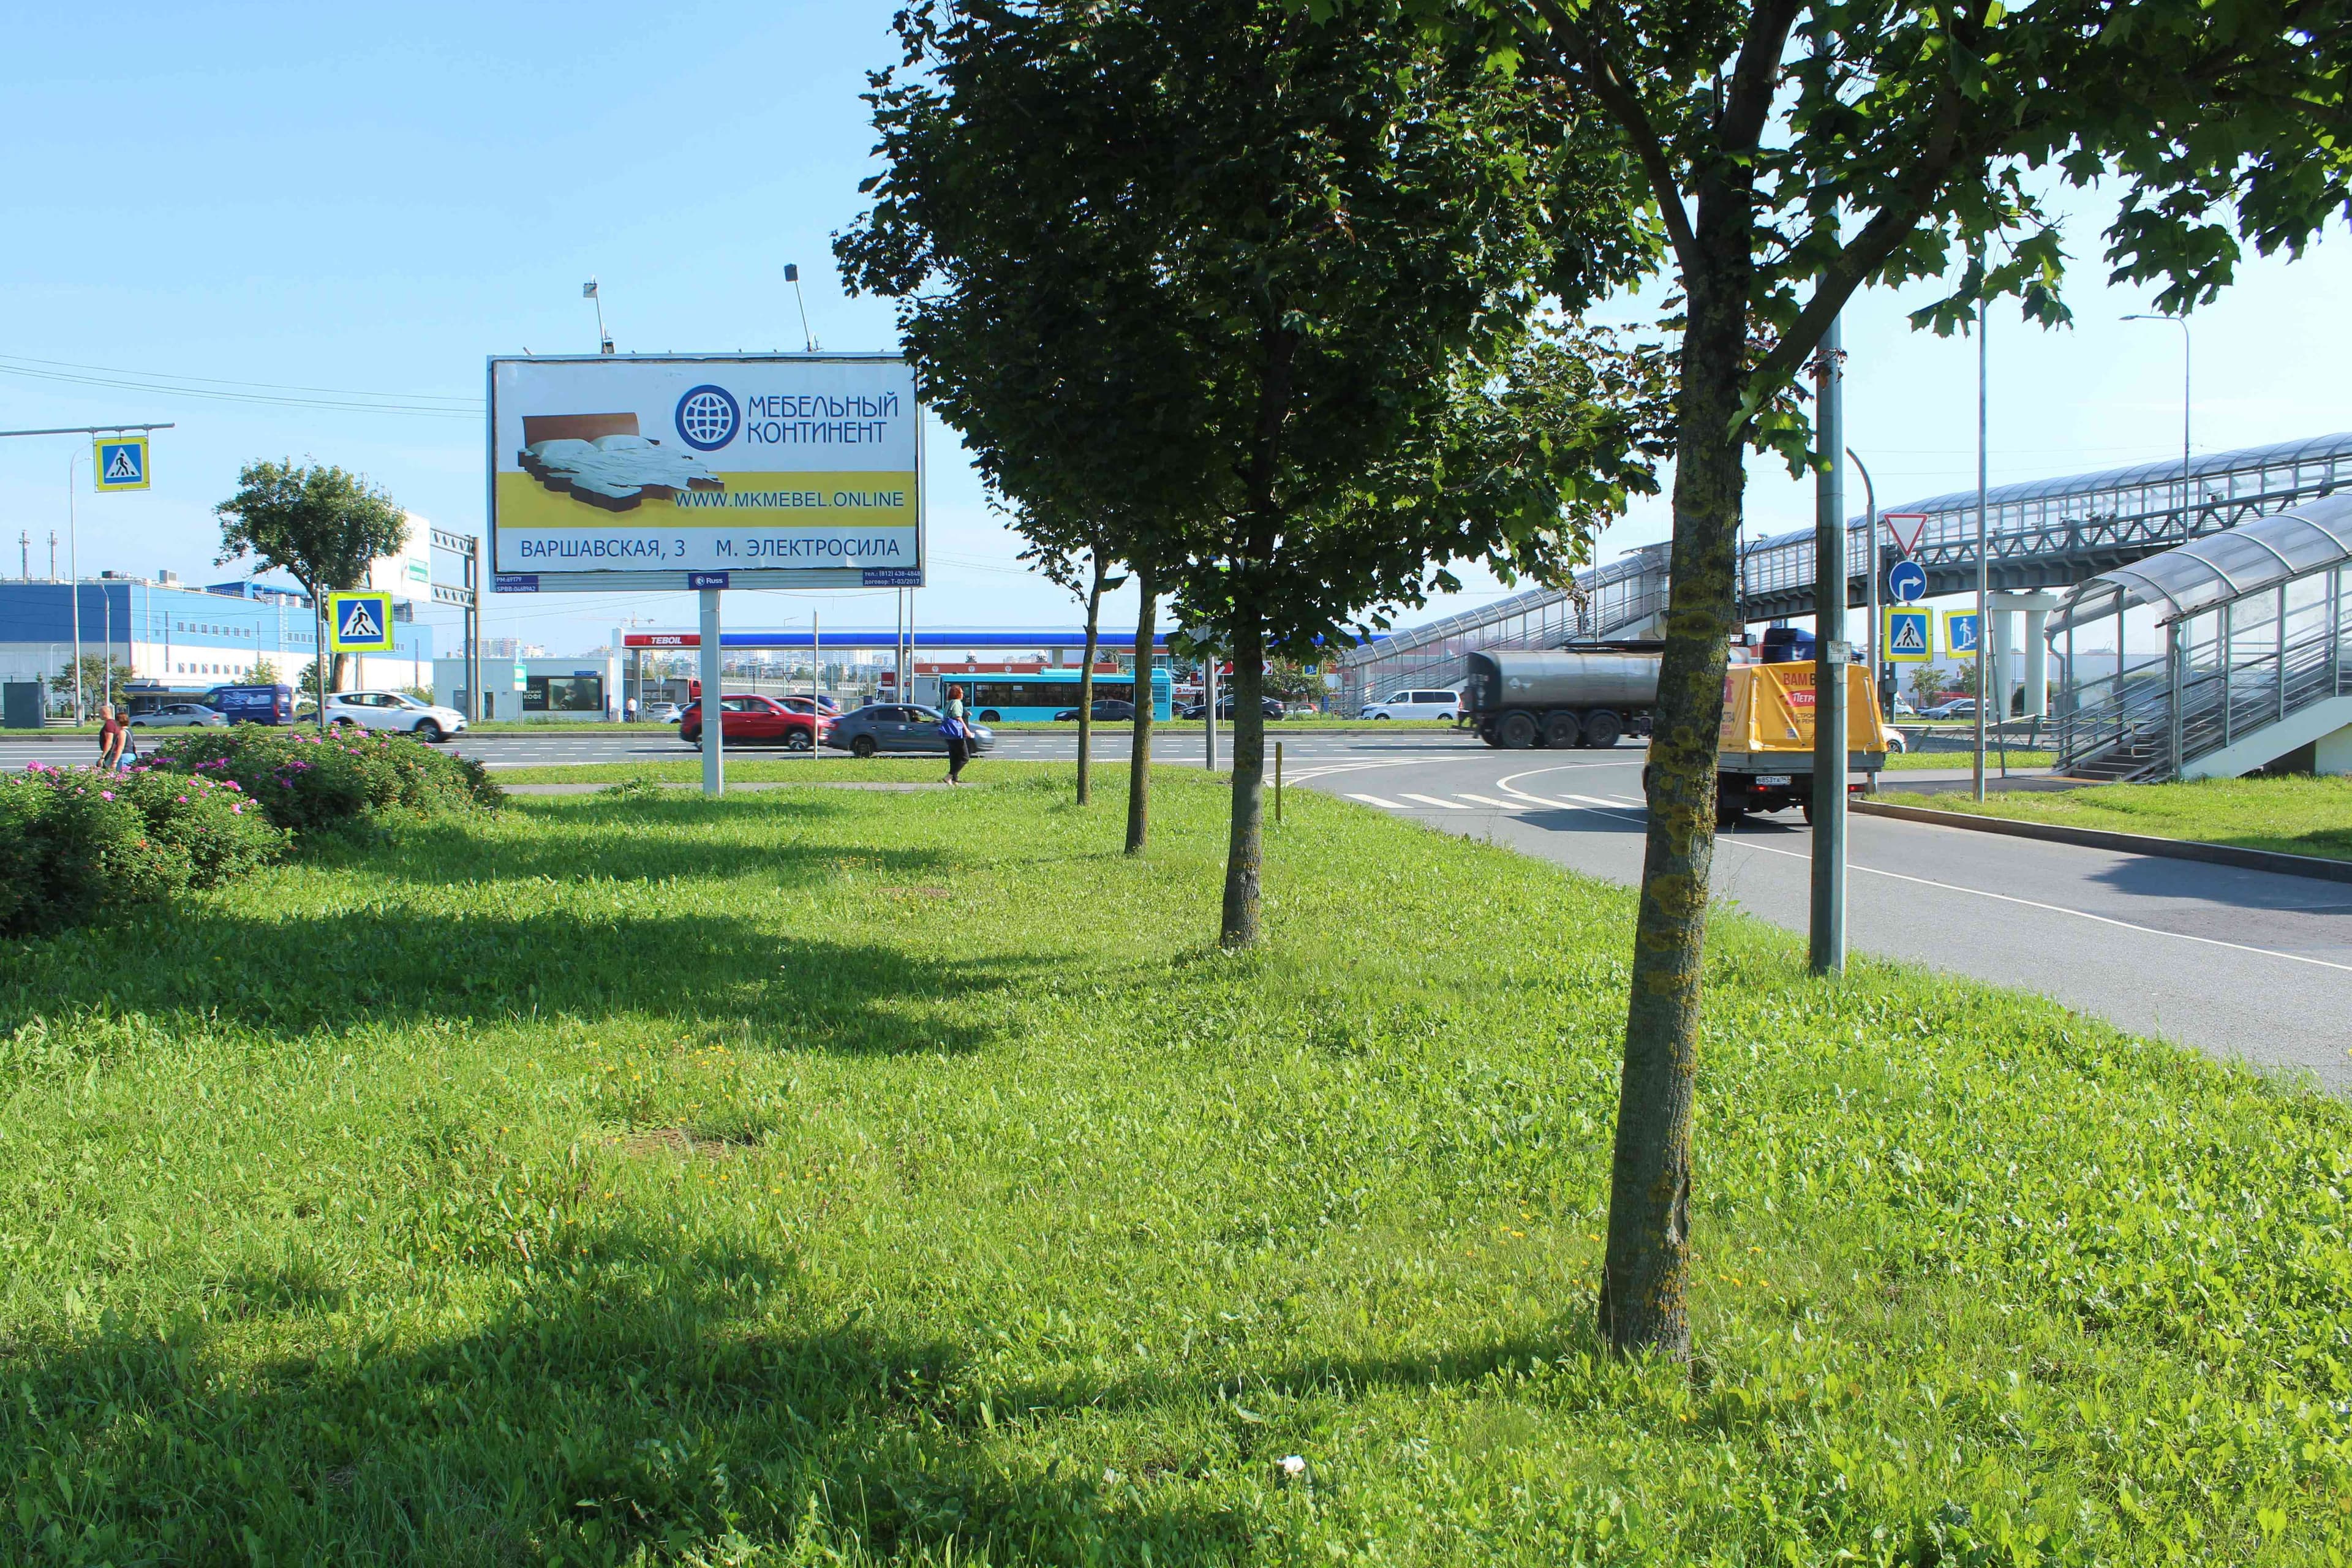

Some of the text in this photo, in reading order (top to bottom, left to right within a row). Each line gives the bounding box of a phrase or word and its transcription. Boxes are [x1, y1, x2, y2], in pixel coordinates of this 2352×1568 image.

[748, 391, 899, 418] МЕБЕЛЬНЫЙ
[747, 421, 888, 444] КОНТИНЕНТ
[674, 491, 904, 508] WWW.MKMEBEL.ONLINE
[521, 538, 901, 560] ВАРШАВСКАЯ, 3 М. ЭЛЕКТРОСИЛА
[1783, 672, 1807, 685] ВАМ
